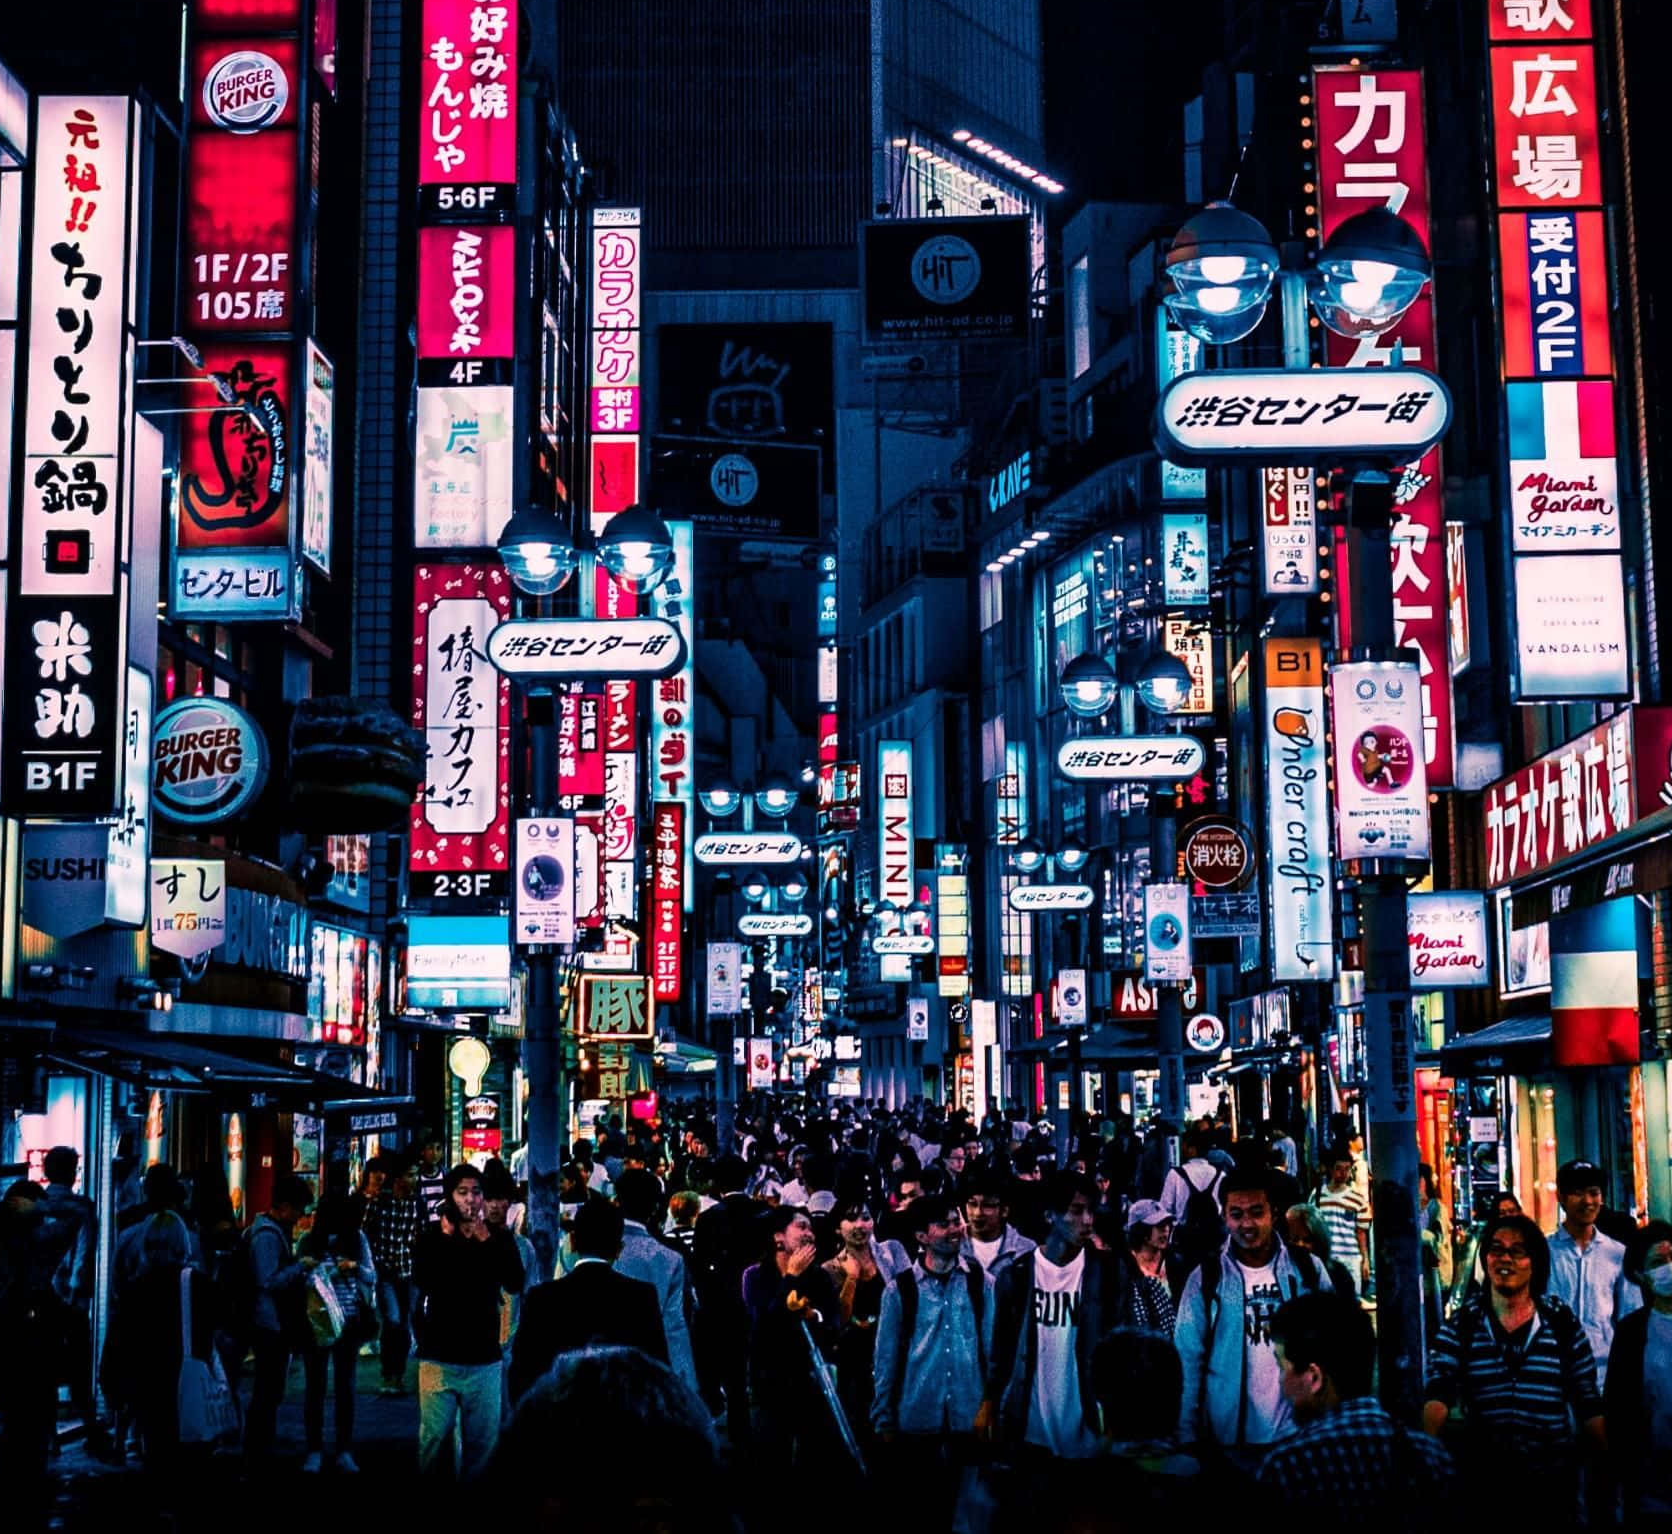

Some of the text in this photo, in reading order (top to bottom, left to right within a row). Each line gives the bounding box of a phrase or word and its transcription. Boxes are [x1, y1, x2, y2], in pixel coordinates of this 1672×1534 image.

[215, 68, 274, 95] BURGER
[218, 81, 276, 113] KING
[428, 36, 466, 173] もんじゃ
[193, 251, 289, 284] 1F/2F
[197, 290, 286, 322] 105席
[598, 232, 636, 384] カラオケ
[1528, 215, 1578, 372] 受付2F
[33, 241, 108, 515] ちりとり鍋
[450, 362, 482, 383] 4F
[598, 389, 632, 407] 受付
[1177, 392, 1432, 425] 渋谷センター街
[598, 408, 633, 429] 3F
[1518, 472, 1597, 493] Miami
[1518, 522, 1616, 537] マイアミガーデン
[180, 568, 285, 598] センタービル
[499, 634, 672, 659] 渋谷センター街
[1277, 651, 1311, 672] B1
[1526, 643, 1619, 654] VANDALISM
[30, 610, 95, 739] 米助
[608, 680, 630, 748] ラーメン
[155, 727, 241, 758] BURGER
[156, 748, 243, 788] KING
[1065, 749, 1196, 768] 渋谷センター街
[26, 761, 98, 792] B1F
[1485, 714, 1631, 886] カラオケ歌広場
[25, 858, 106, 881] SUSHI
[1192, 844, 1241, 867] 消火栓
[155, 866, 221, 902] すし
[1192, 897, 1260, 916] セキネ
[657, 942, 676, 954] 2F
[657, 962, 676, 974] 3F
[657, 982, 676, 994] 4F
[589, 981, 645, 1033] 豚
